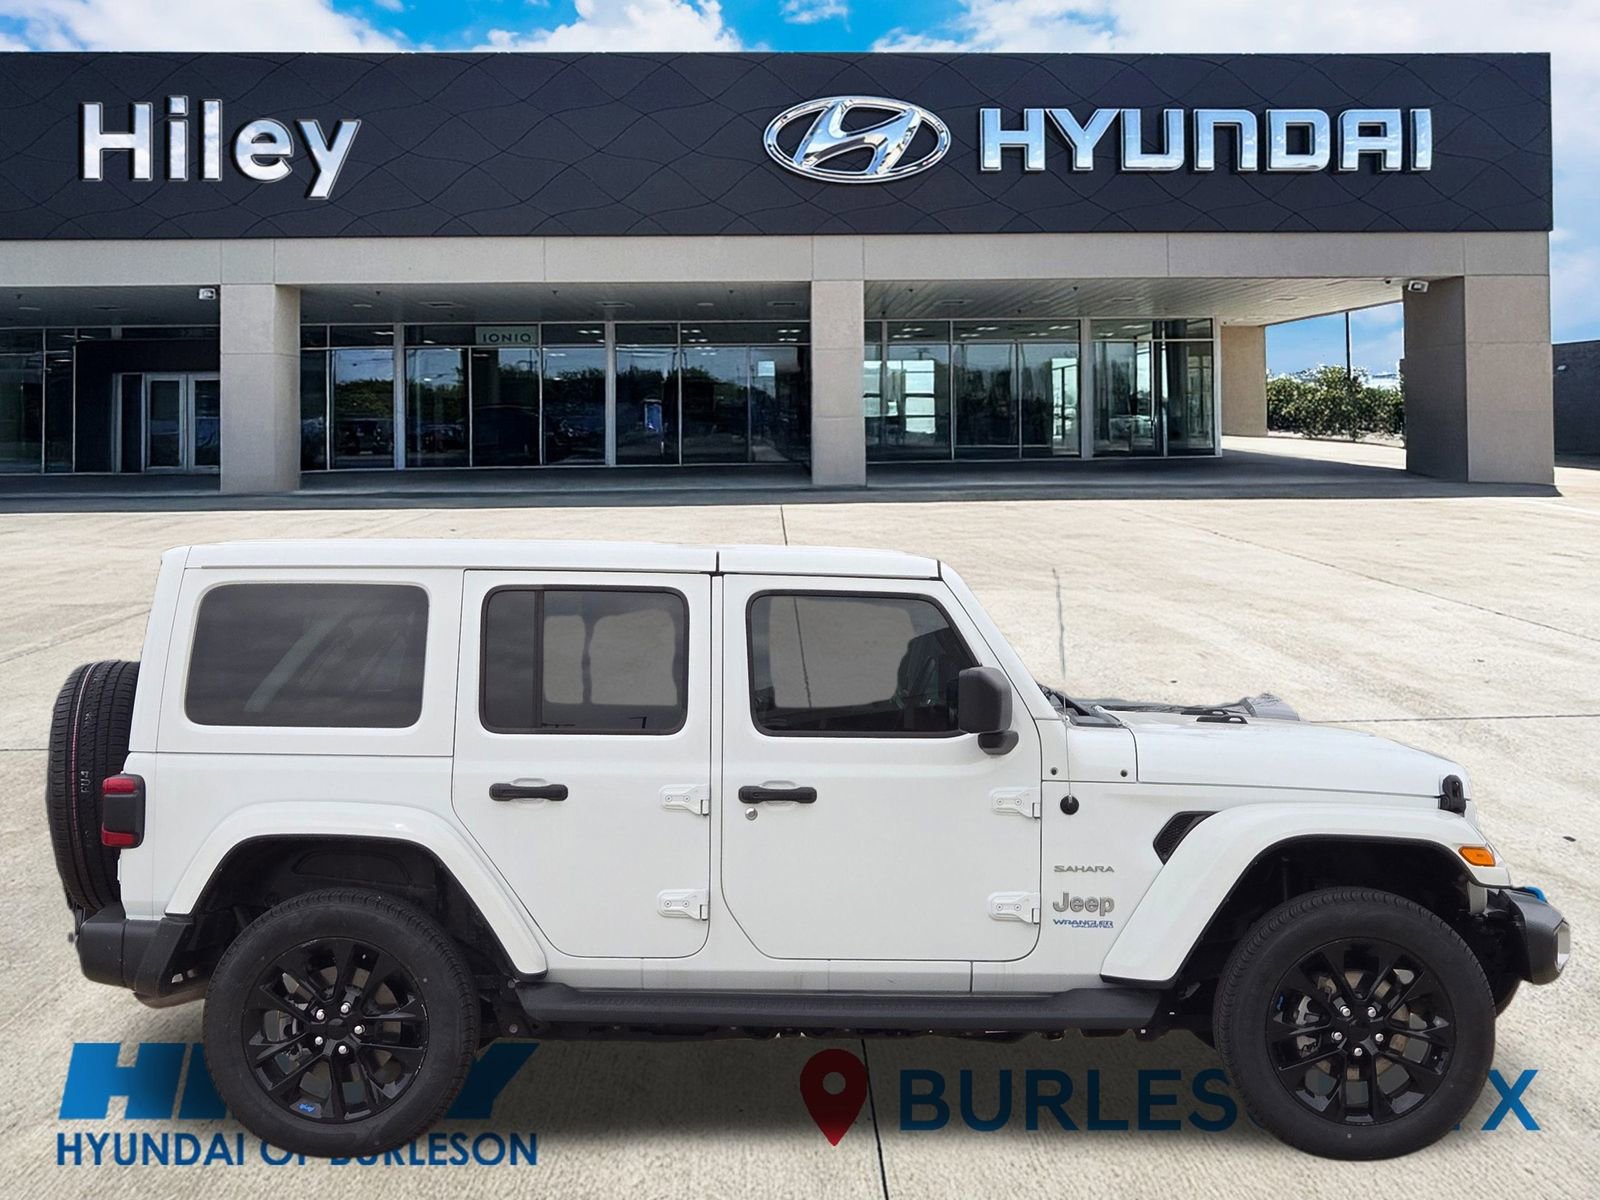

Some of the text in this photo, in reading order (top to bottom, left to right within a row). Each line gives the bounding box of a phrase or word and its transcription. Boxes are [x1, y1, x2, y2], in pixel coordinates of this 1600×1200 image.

[80, 95, 362, 199] Hiley
[979, 107, 1433, 172] HYUNDAI
[483, 333, 531, 343] IONIQ
[1053, 865, 1115, 873] SAHARA
[1052, 892, 1115, 917] Jeep
